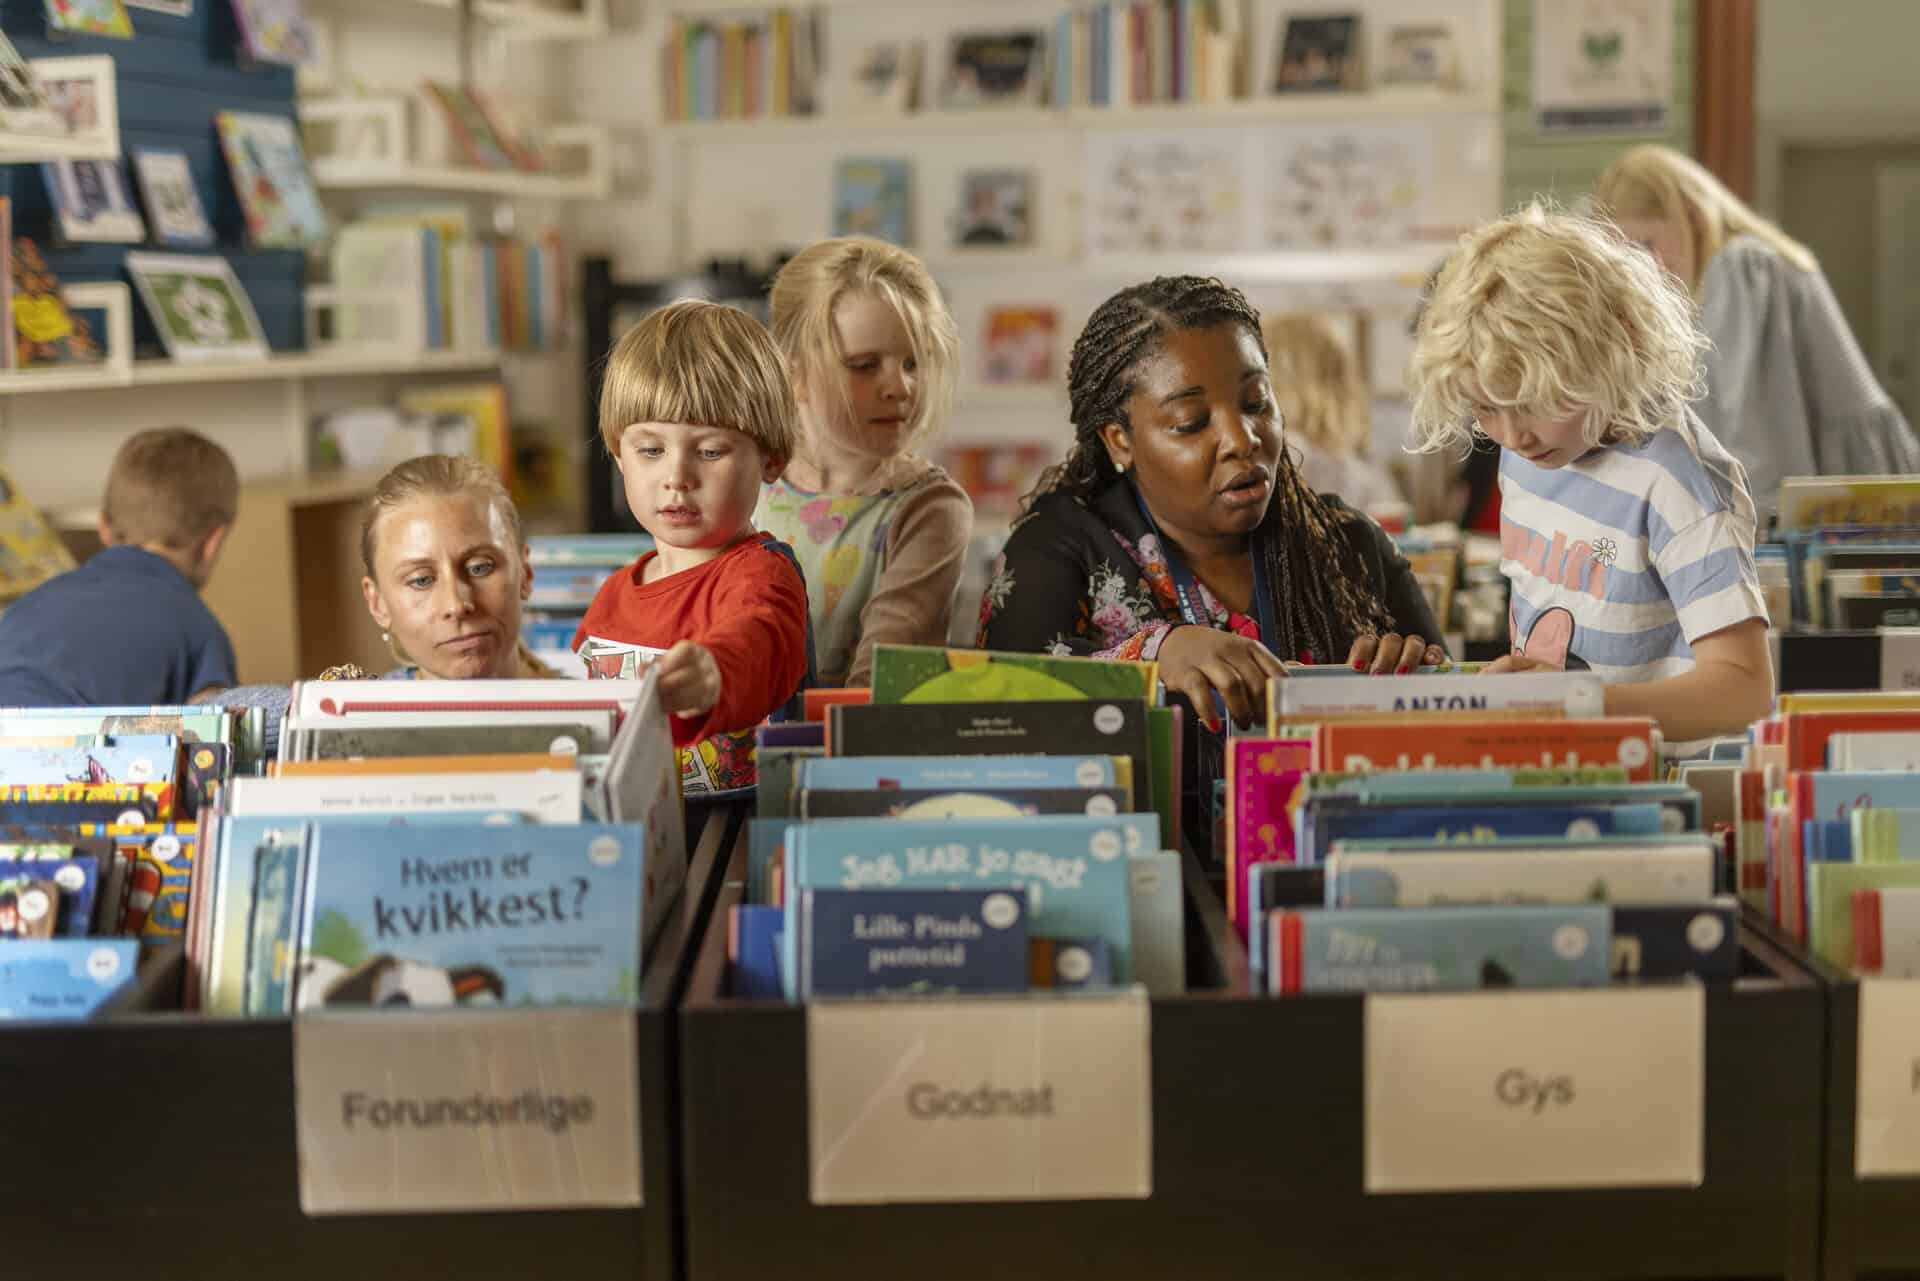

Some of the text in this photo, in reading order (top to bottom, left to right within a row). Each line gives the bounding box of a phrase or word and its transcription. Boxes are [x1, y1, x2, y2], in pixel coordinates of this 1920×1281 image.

[402, 853, 532, 885] Hvem er
[374, 877, 590, 937] kvikkest?
[853, 914, 909, 939] Lille
[341, 1088, 595, 1133] Forunderlige
[905, 1081, 1055, 1120] Godnat
[1496, 1068, 1577, 1115] Gys
